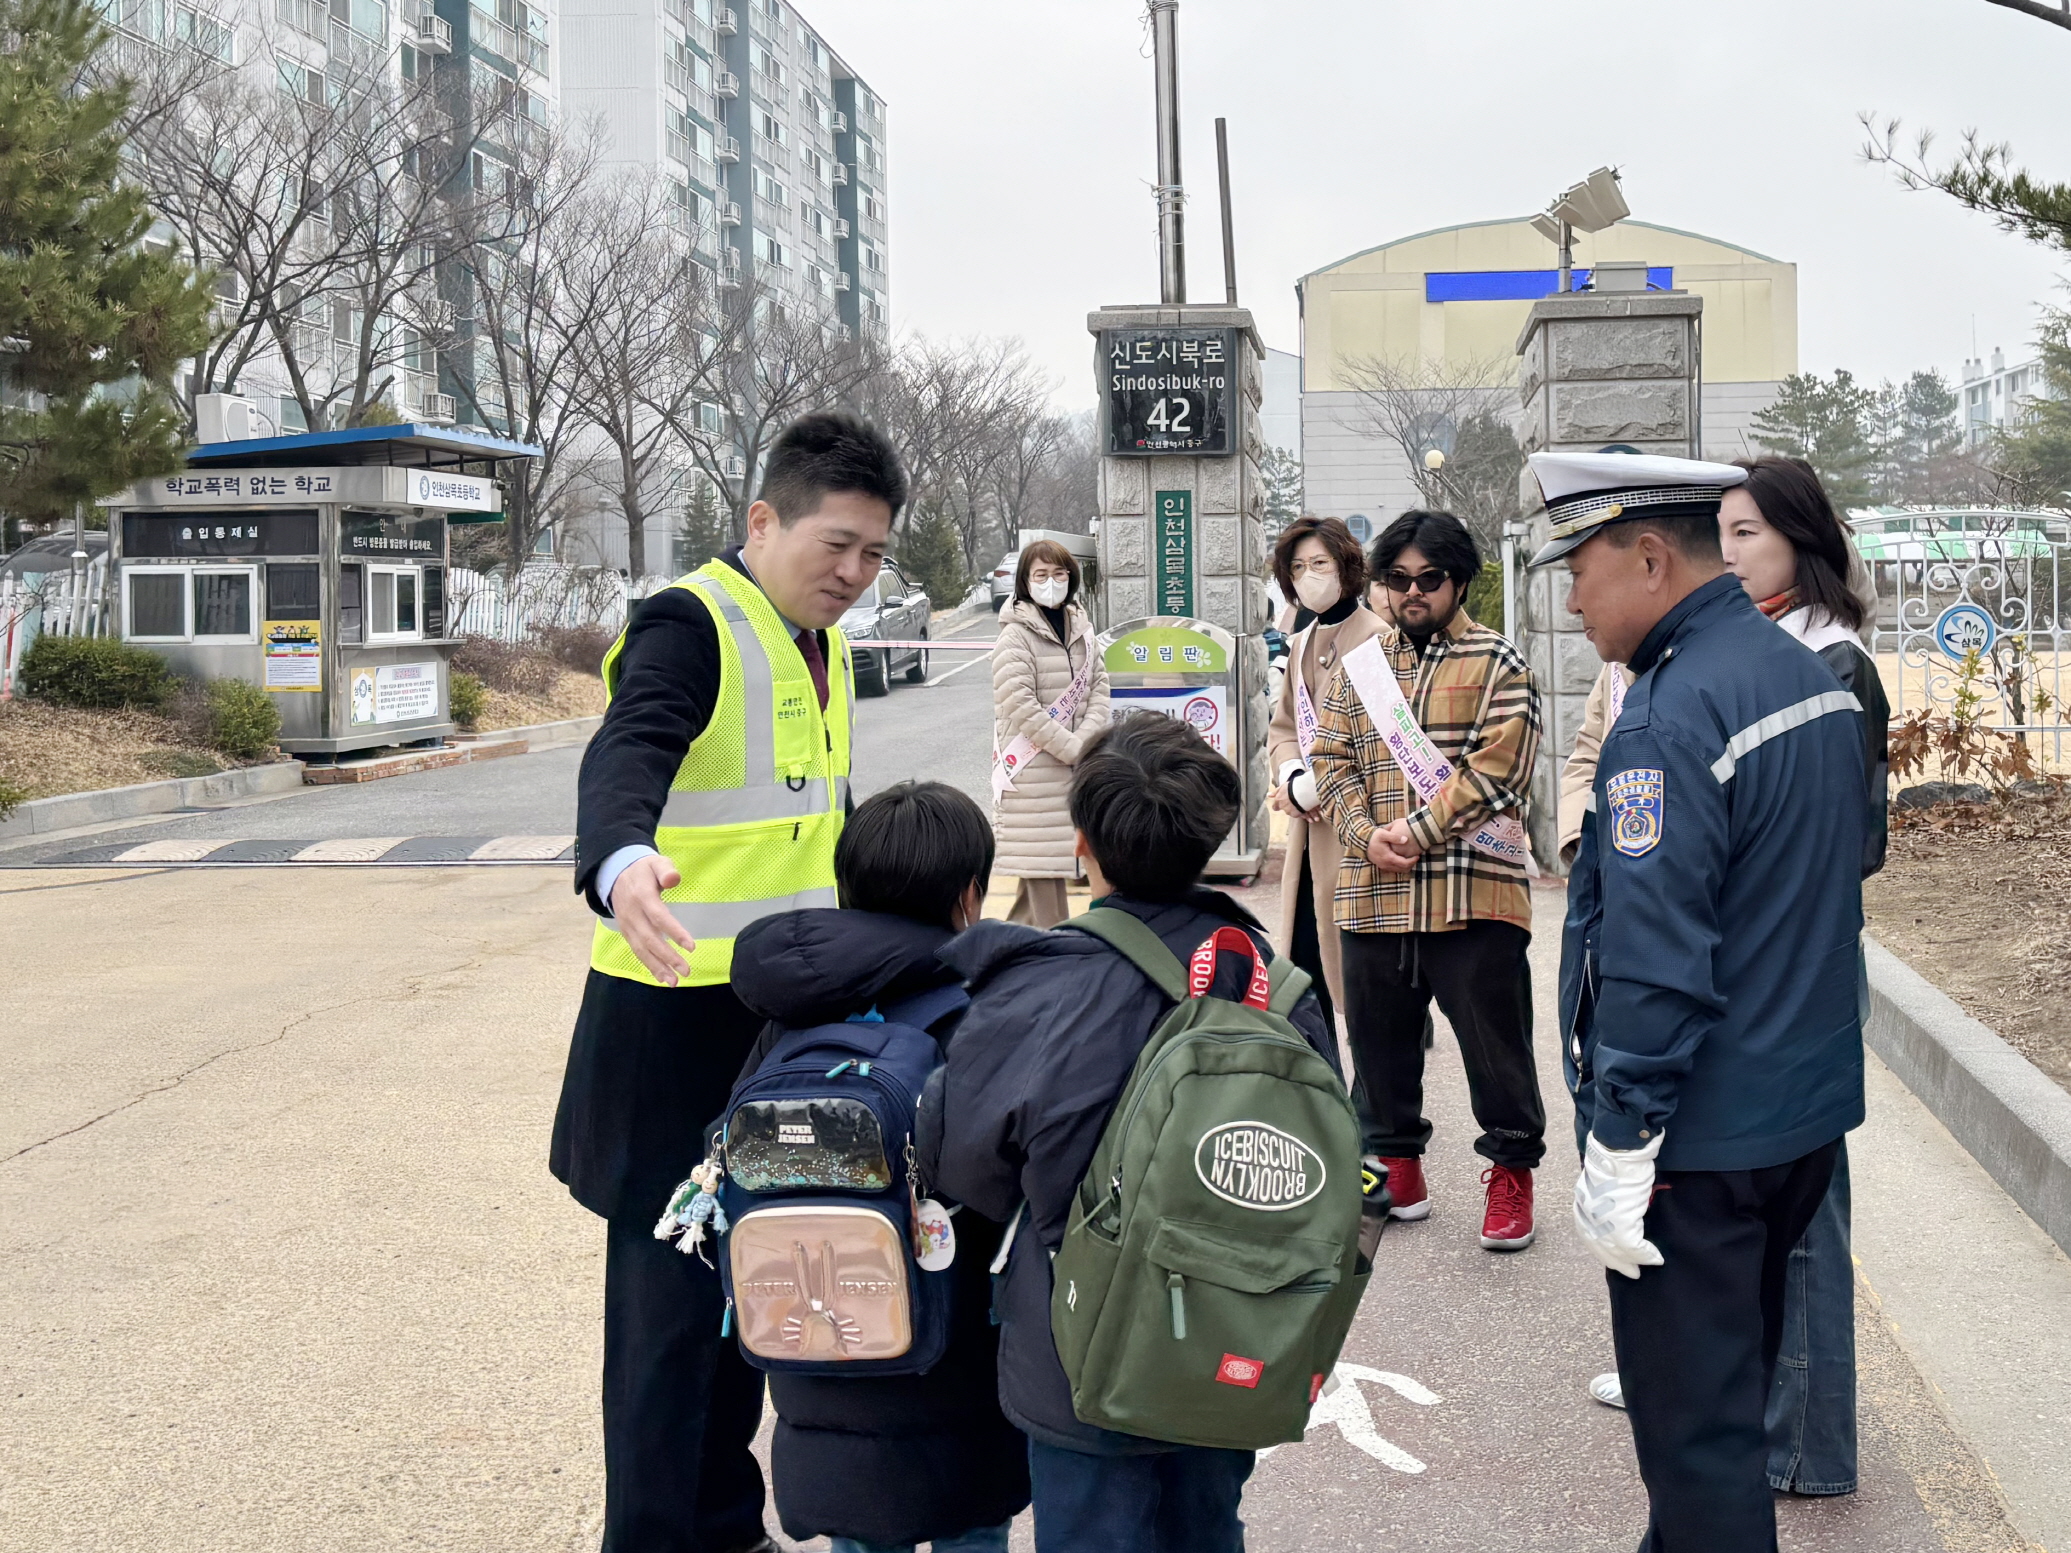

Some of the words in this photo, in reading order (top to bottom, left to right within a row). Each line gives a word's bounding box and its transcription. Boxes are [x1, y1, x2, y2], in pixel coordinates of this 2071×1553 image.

[1110, 340, 1225, 369] 신도시북로
[1112, 374, 1225, 391] Sindosibuk-ro
[1146, 397, 1191, 432] 42
[165, 476, 240, 496] 학교폭력
[250, 476, 287, 495] 없는
[294, 475, 332, 495] 학교
[432, 481, 481, 501] 인천삼목초등학교
[1163, 497, 1186, 614] 인천삼목초등
[1961, 637, 1982, 648] 삼목
[1133, 647, 1199, 662] 알림판
[778, 1134, 815, 1144] JENSEN
[779, 1124, 812, 1134] PETER
[1214, 1130, 1306, 1172] ICEBISCUIT
[1211, 1159, 1306, 1203] BROOKLYN
